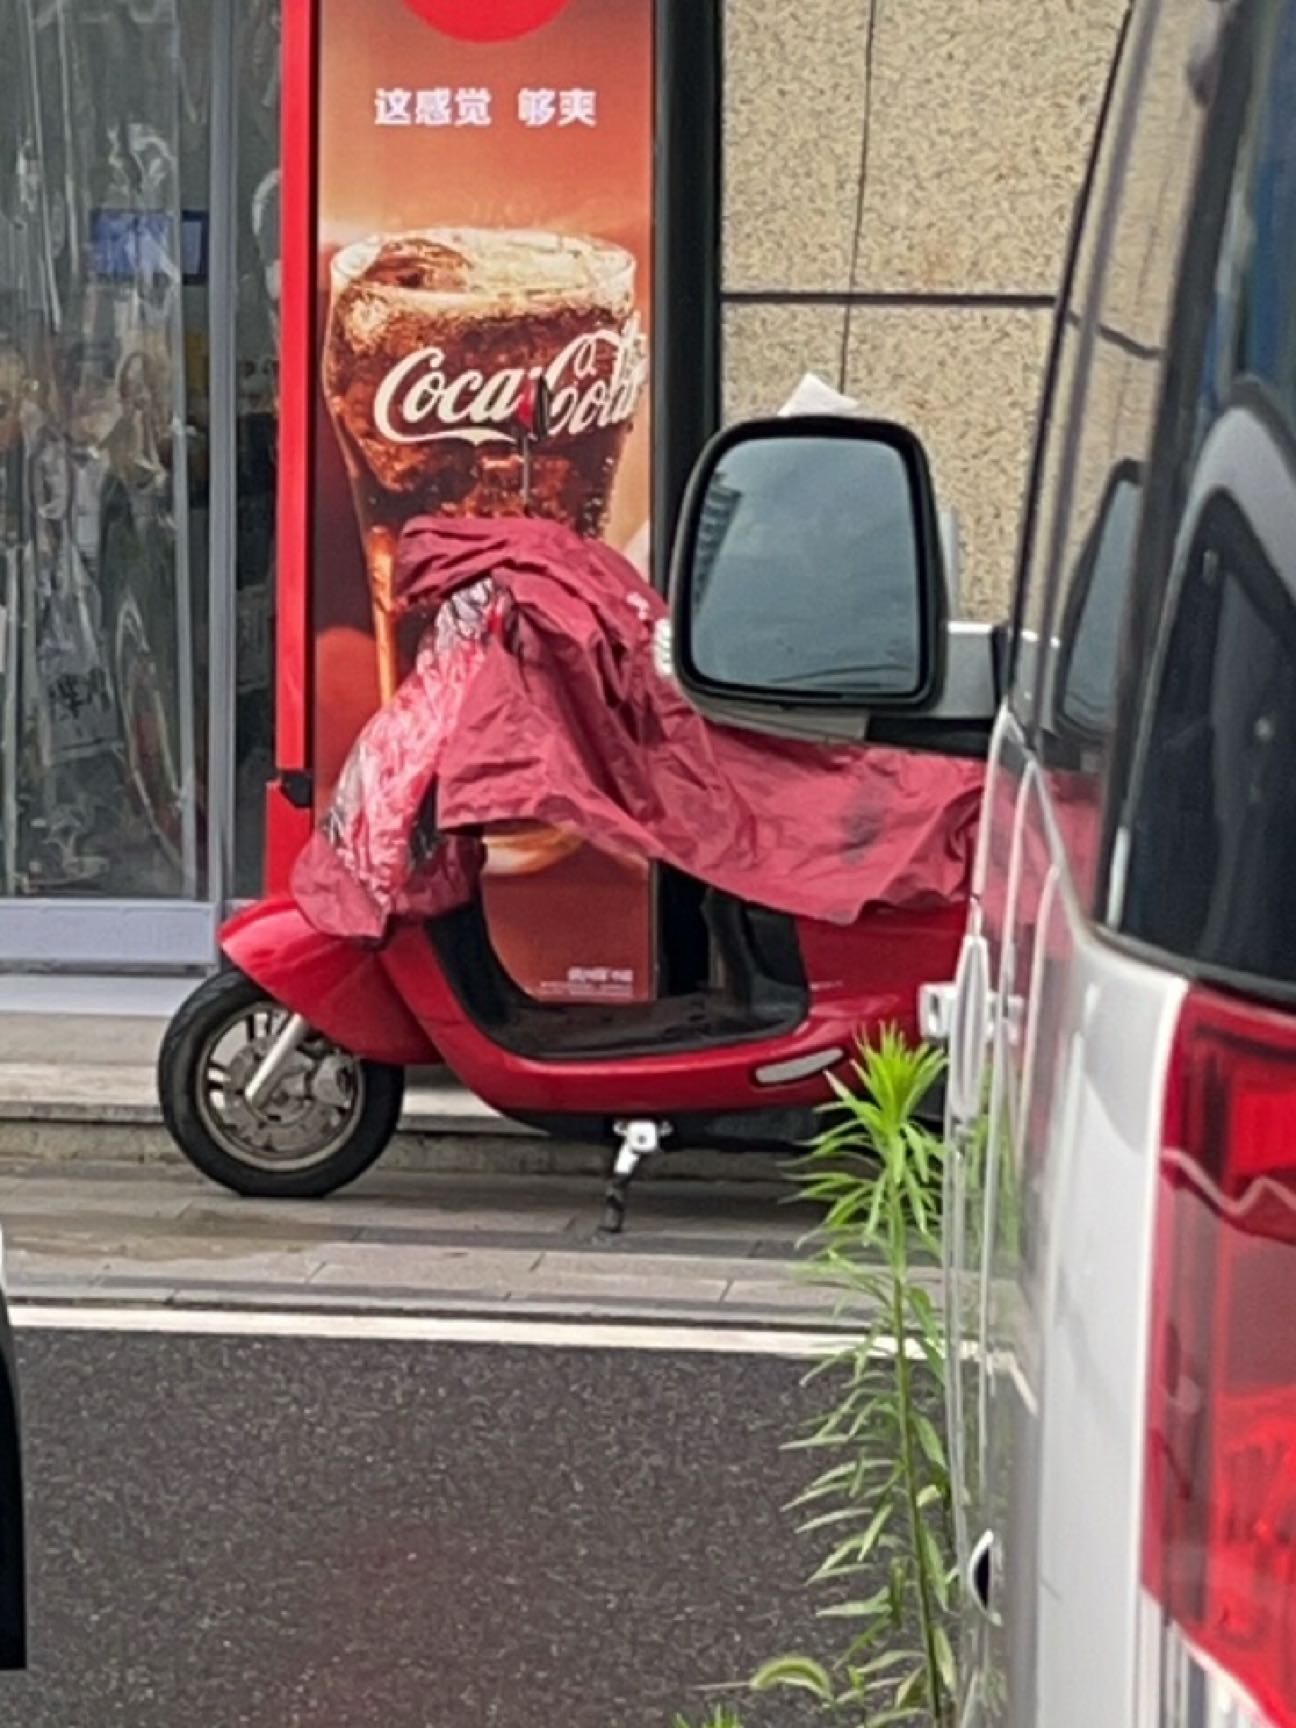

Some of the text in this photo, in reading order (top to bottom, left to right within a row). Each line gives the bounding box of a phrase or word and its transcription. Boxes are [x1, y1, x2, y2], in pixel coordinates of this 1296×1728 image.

[373, 86, 598, 127] 这感觉 够爽
